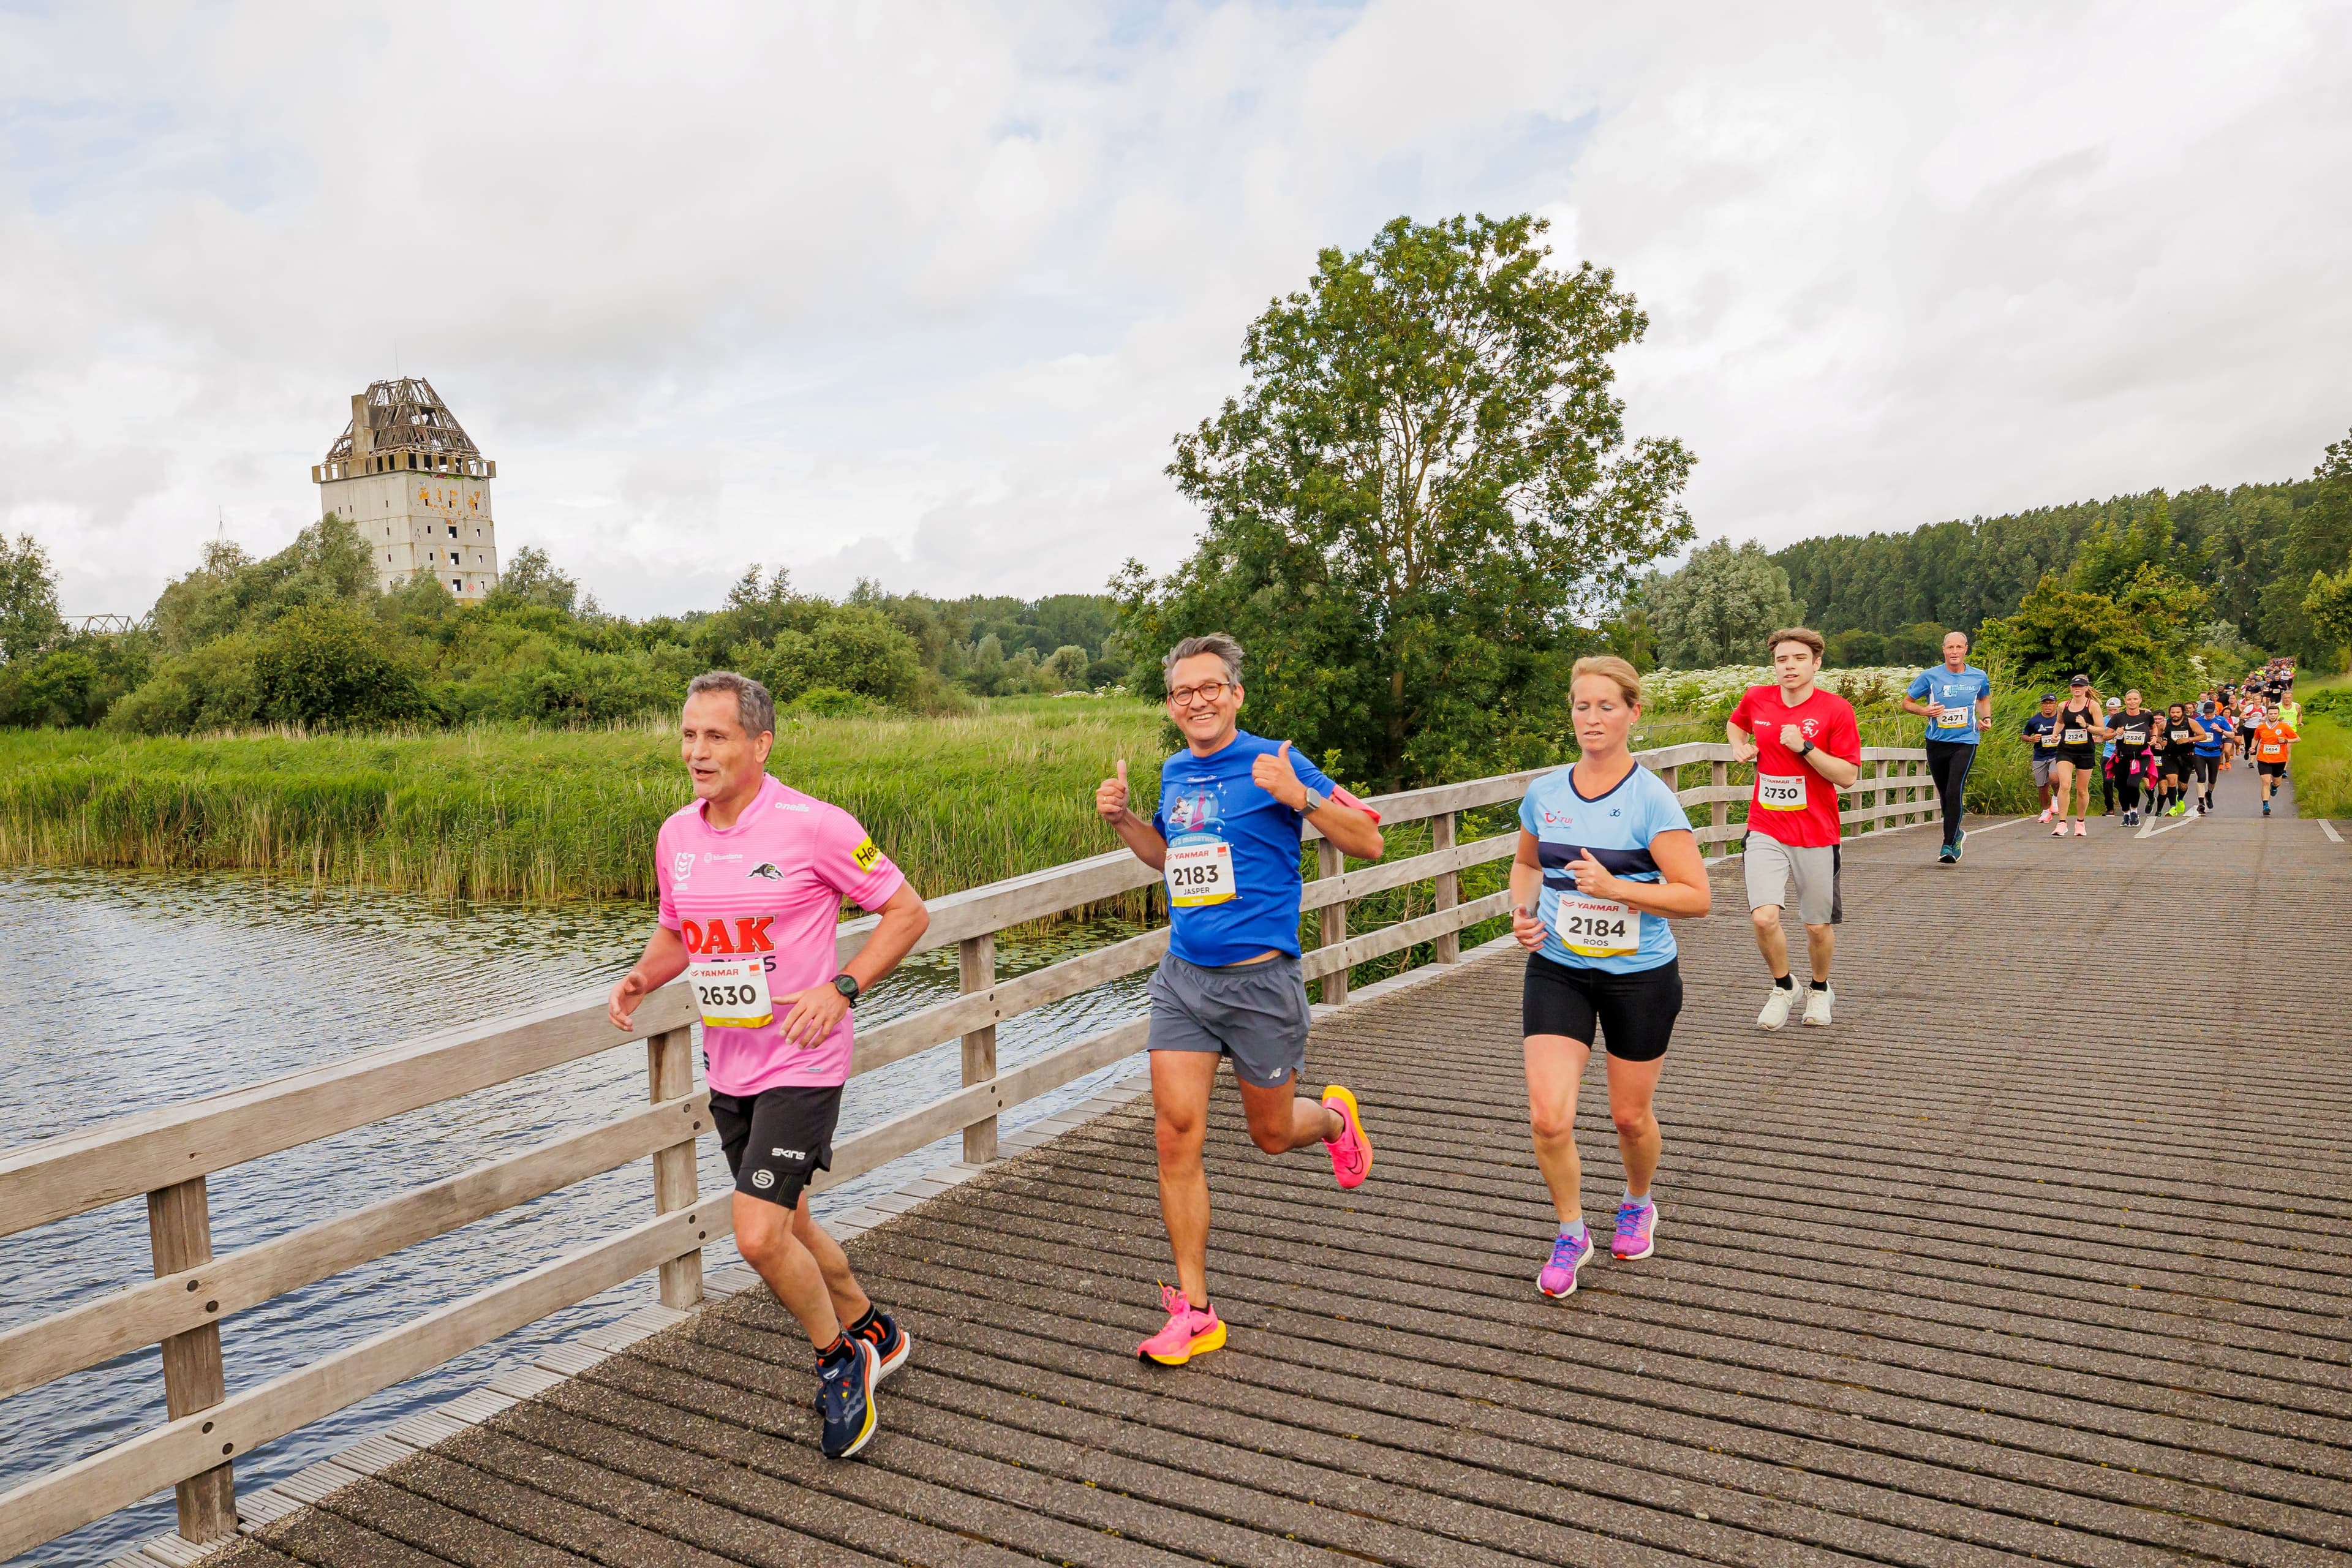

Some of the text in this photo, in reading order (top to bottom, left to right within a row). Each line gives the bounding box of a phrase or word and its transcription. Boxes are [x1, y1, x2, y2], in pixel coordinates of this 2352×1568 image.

[1765, 786, 1798, 799] 2730
[1174, 850, 1210, 860] YANMAR
[1172, 864, 1219, 886] 2183
[1183, 887, 1210, 895] JASPER
[1577, 902, 1619, 912] YANMAR
[1568, 916, 1626, 938] 2184
[680, 915, 776, 956] OAK
[701, 968, 739, 977] YANMAR
[699, 984, 756, 1006] 2630
